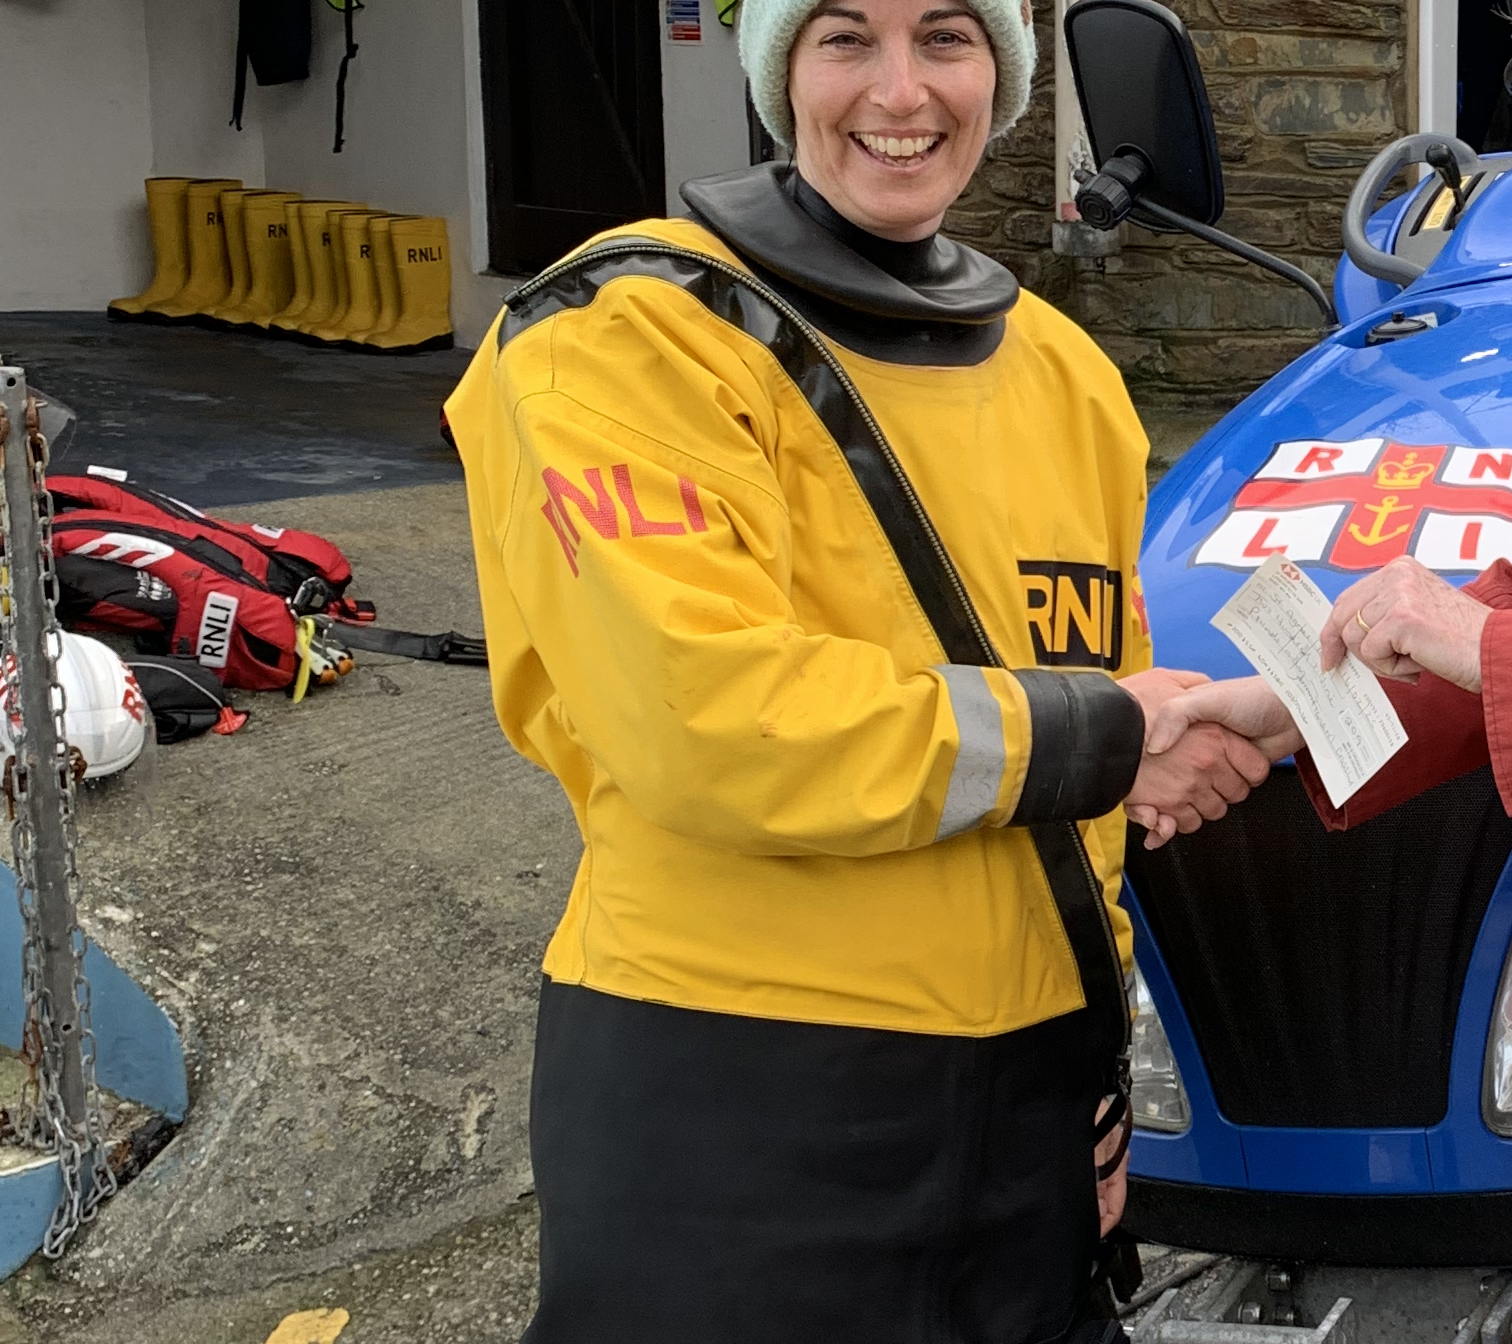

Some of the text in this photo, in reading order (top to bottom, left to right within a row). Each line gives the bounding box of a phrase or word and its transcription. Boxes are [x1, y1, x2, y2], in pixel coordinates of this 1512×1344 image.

[407, 246, 443, 263] RNLI
[1294, 446, 1345, 474] R
[1242, 518, 1288, 558] L
[201, 603, 233, 659] RNLI
